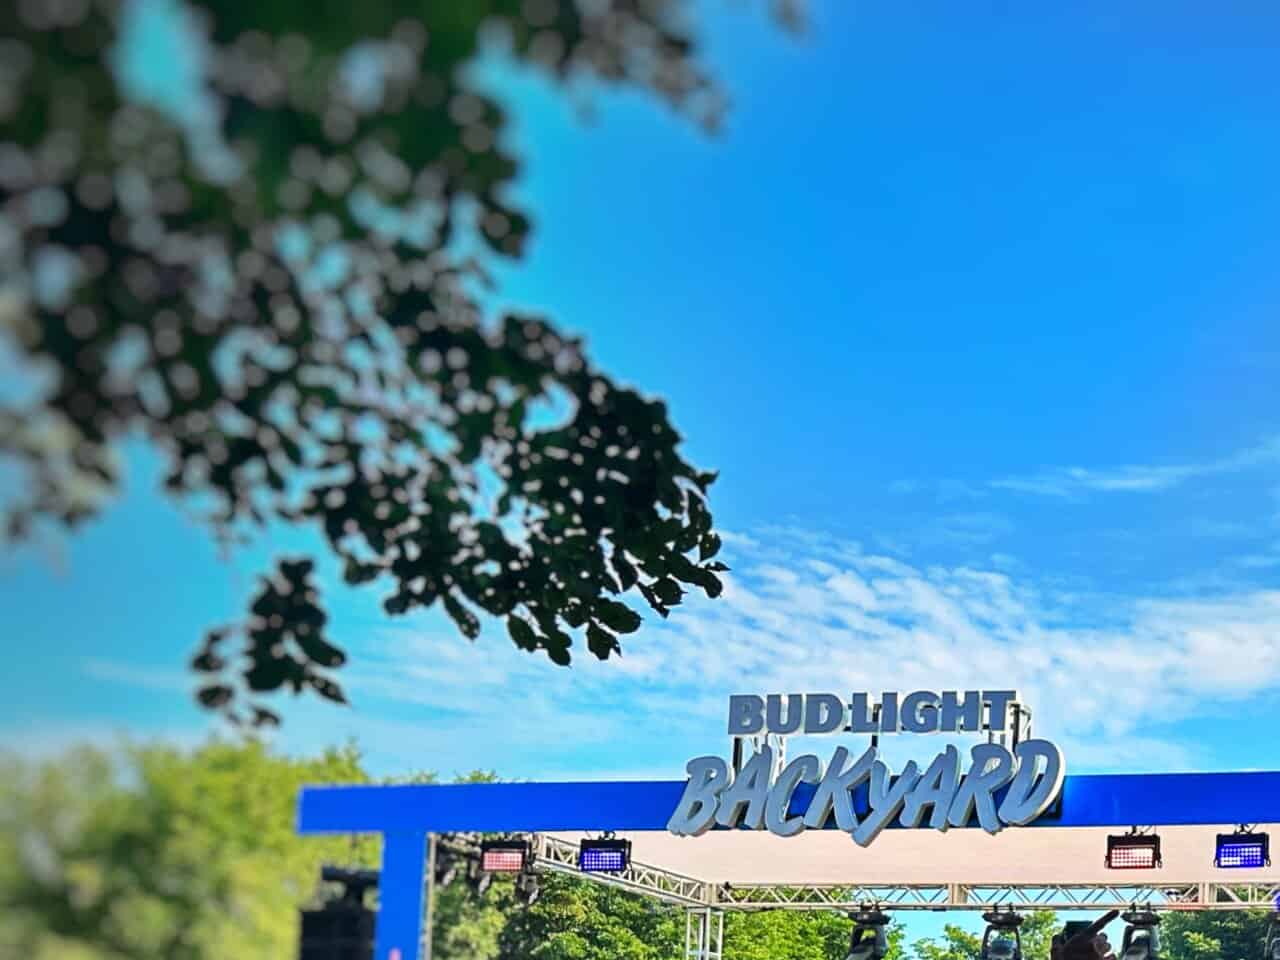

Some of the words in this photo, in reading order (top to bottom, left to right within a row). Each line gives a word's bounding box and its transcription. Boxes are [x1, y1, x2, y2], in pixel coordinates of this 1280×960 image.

[728, 692, 844, 735] BUD
[843, 690, 1017, 734] LIGHT
[666, 738, 1065, 848] BACKYARD
